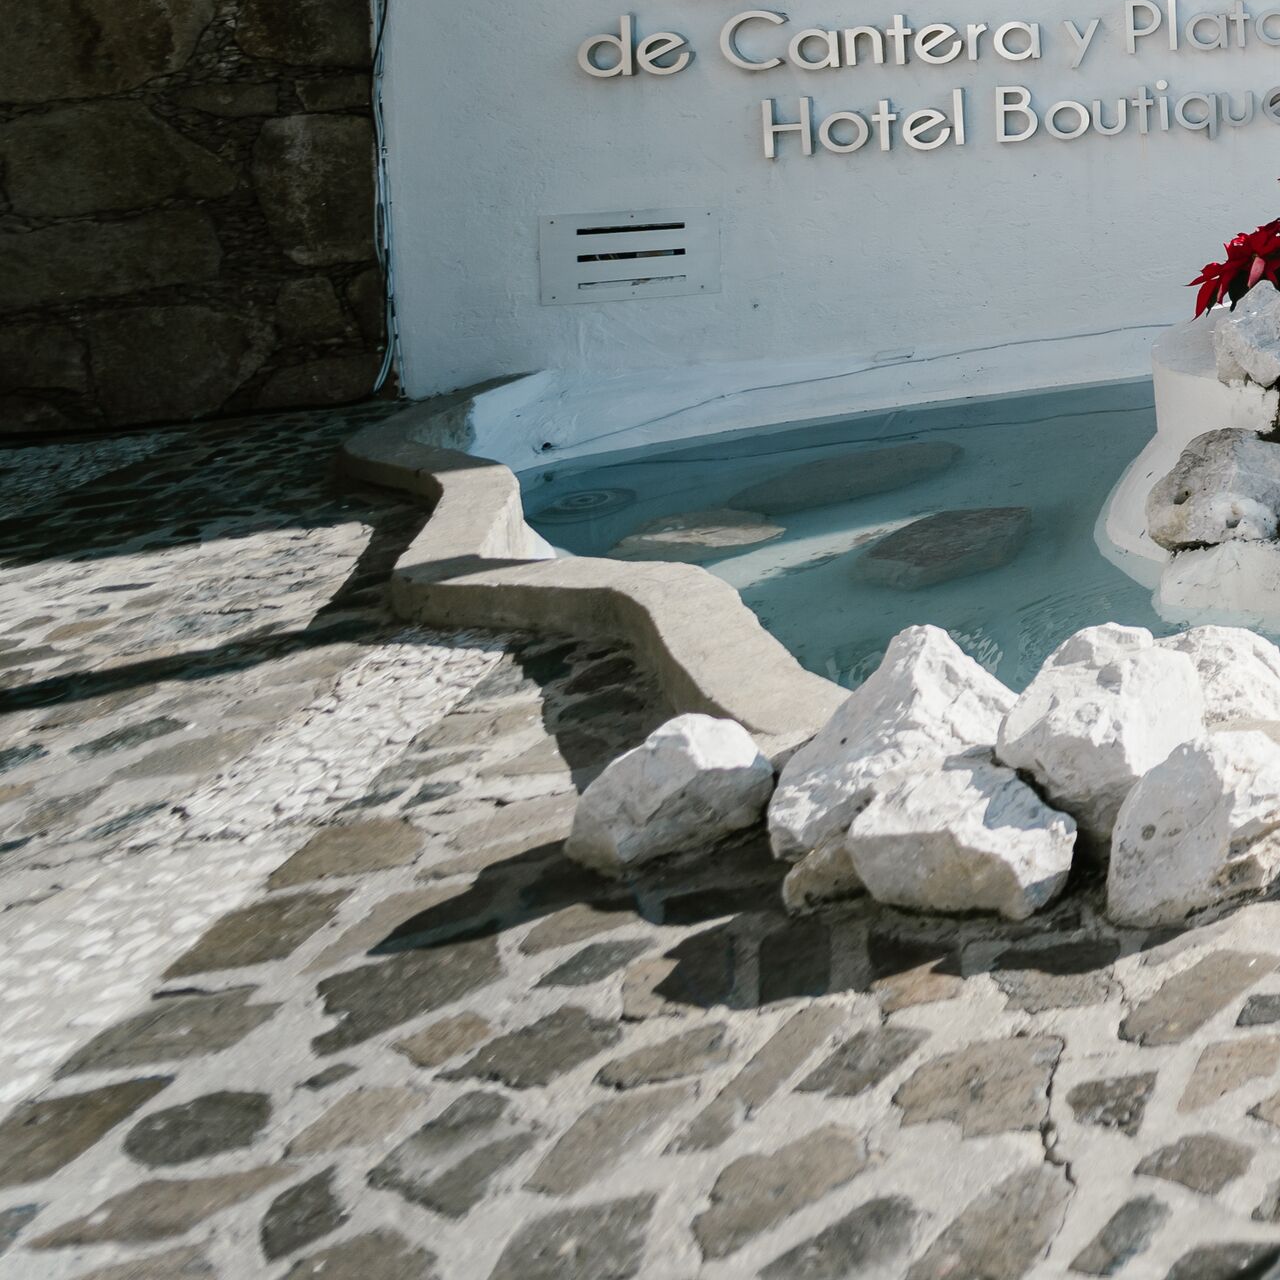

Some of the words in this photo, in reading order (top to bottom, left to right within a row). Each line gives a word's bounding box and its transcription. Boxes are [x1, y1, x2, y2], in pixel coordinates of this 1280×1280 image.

[576, 14, 693, 78] de
[719, 9, 1042, 72] Cantera
[1063, 17, 1102, 69] y
[760, 86, 967, 160] Hotel
